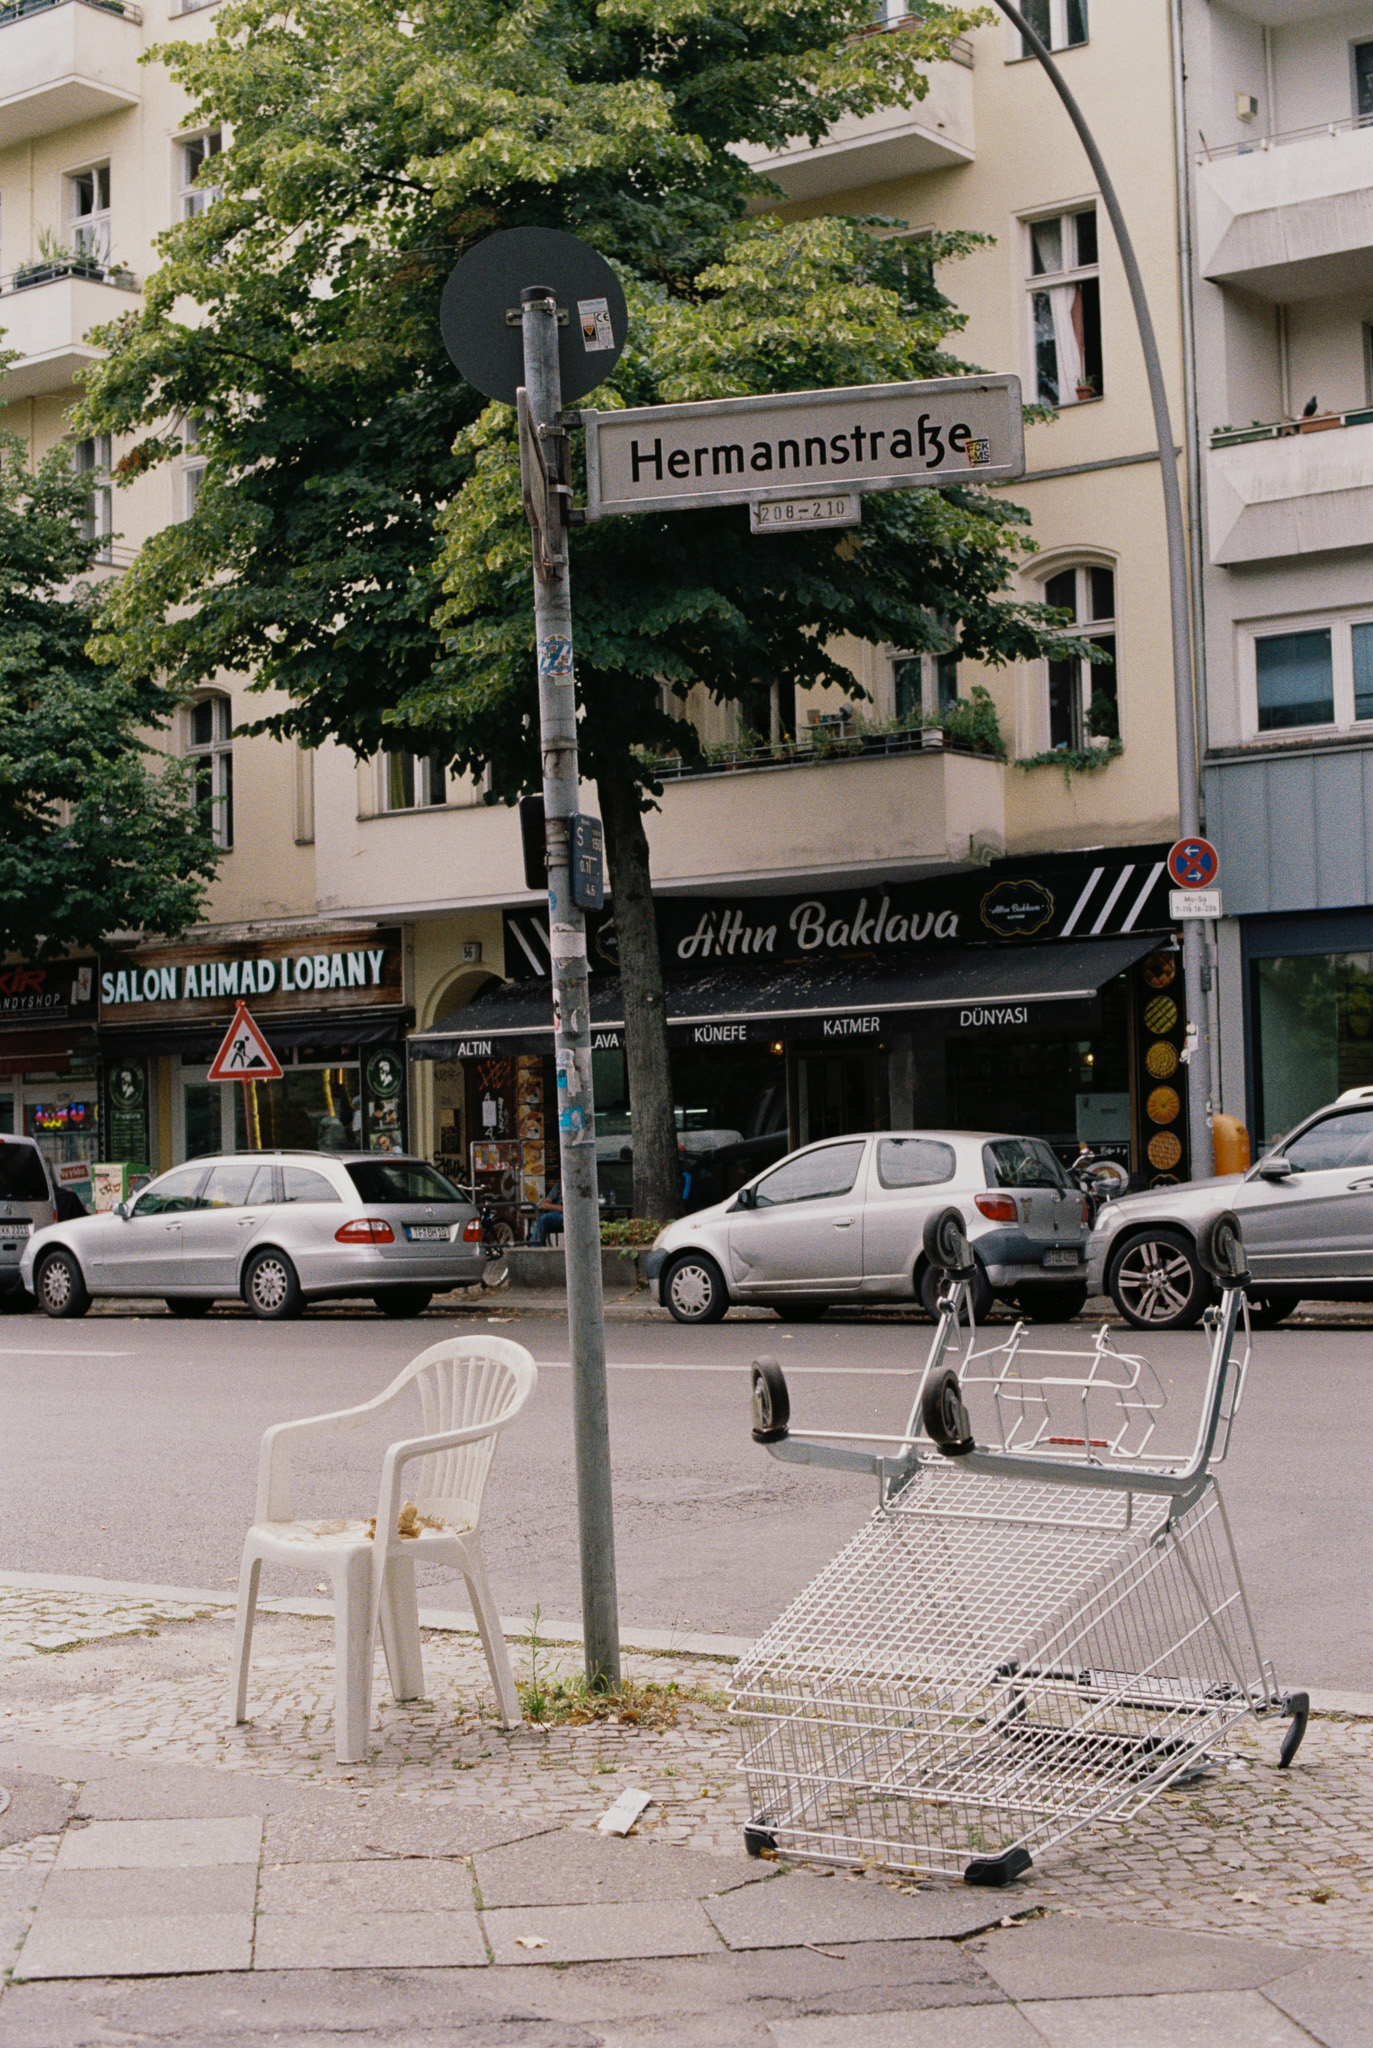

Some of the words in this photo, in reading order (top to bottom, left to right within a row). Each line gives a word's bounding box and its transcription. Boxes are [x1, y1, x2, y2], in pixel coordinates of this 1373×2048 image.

[631, 413, 972, 483] Hermannstraße
[761, 500, 845, 522] 208-210
[789, 896, 959, 950] Baklava
[0, 993, 60, 1009] NDYSHOP
[101, 966, 177, 1004] SALON
[183, 958, 276, 998] AHMAD
[281, 949, 385, 991] LOBANY
[457, 1041, 492, 1056] ALTIN
[694, 1024, 747, 1042] KÜNEFE
[823, 1016, 880, 1036] KATMER
[960, 1007, 1028, 1027] DÜNYASI
